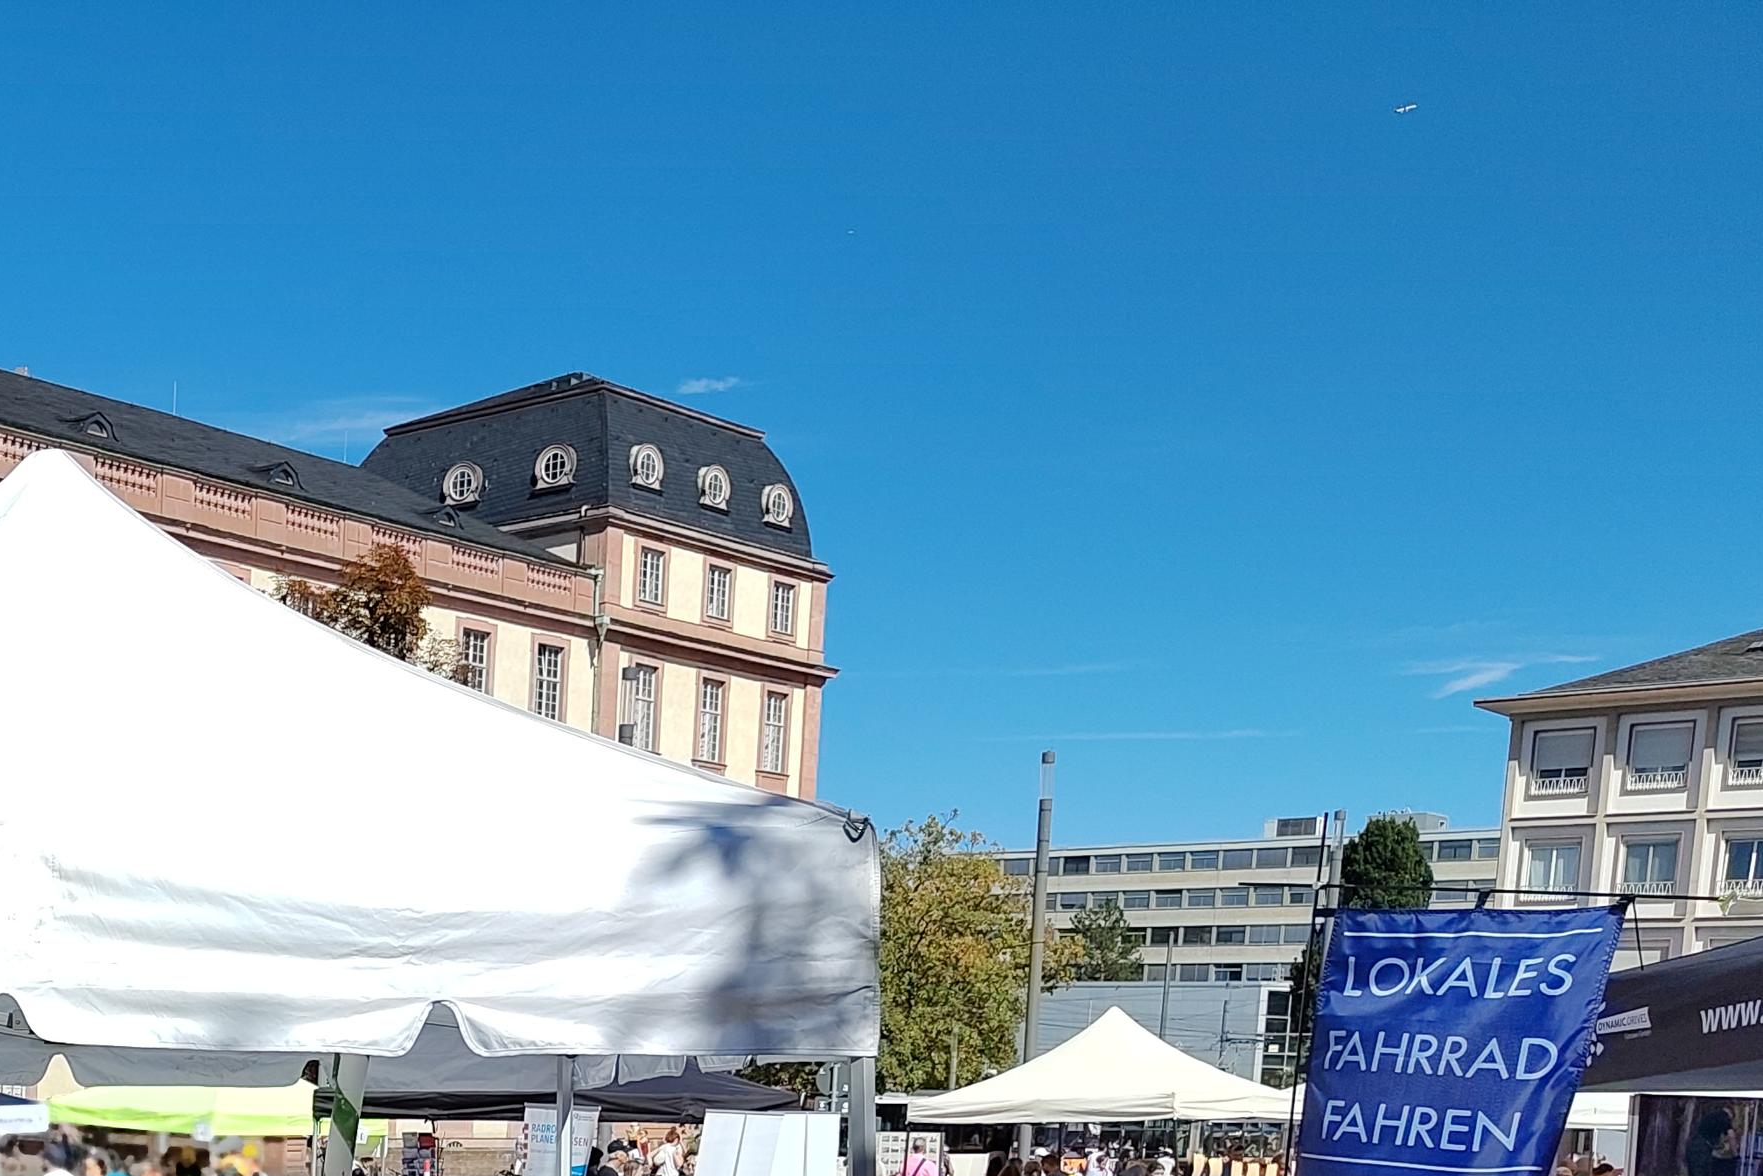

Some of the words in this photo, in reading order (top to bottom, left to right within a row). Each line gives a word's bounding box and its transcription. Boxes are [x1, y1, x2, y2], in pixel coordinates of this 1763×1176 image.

[1343, 954, 1577, 999] LOKALES
[1323, 1030, 1558, 1080] FAHRRAD
[1321, 1100, 1521, 1152] FAHREN
